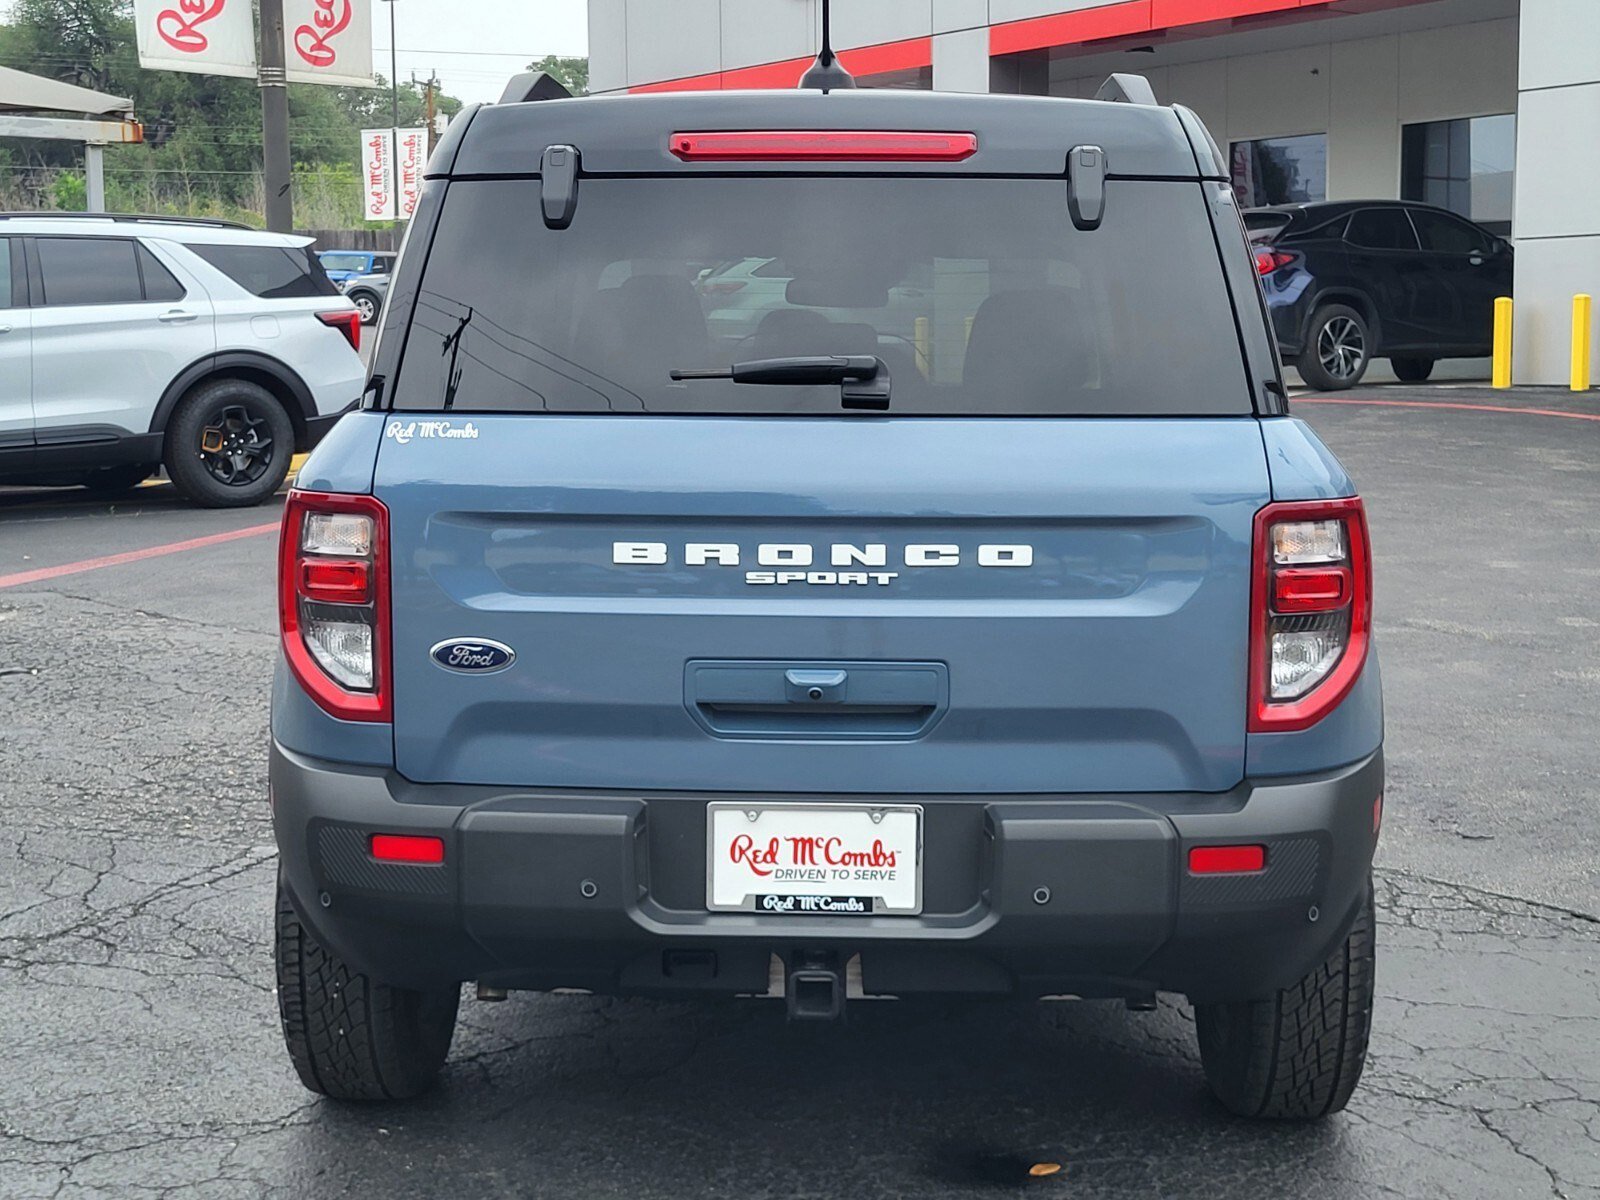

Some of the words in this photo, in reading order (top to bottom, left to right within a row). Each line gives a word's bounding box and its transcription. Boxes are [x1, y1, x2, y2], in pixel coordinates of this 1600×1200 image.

[157, 0, 225, 53] Re
[369, 135, 382, 189] McCombs
[383, 157, 389, 166] TO
[402, 134, 416, 188] McCombs
[416, 156, 422, 166] TO
[371, 191, 388, 215] Red
[386, 421, 417, 444] Red
[418, 421, 479, 438] McCombs
[613, 541, 1033, 567] BRONCO
[745, 571, 898, 585] SPORT
[448, 645, 495, 666] Ford
[730, 834, 780, 877] Red
[784, 836, 897, 868] McCombs
[774, 868, 826, 880] DRIVEN
[831, 869, 850, 880] TO
[853, 870, 896, 881] SERVE
[763, 895, 794, 912] Red
[795, 896, 865, 912] McCombs
